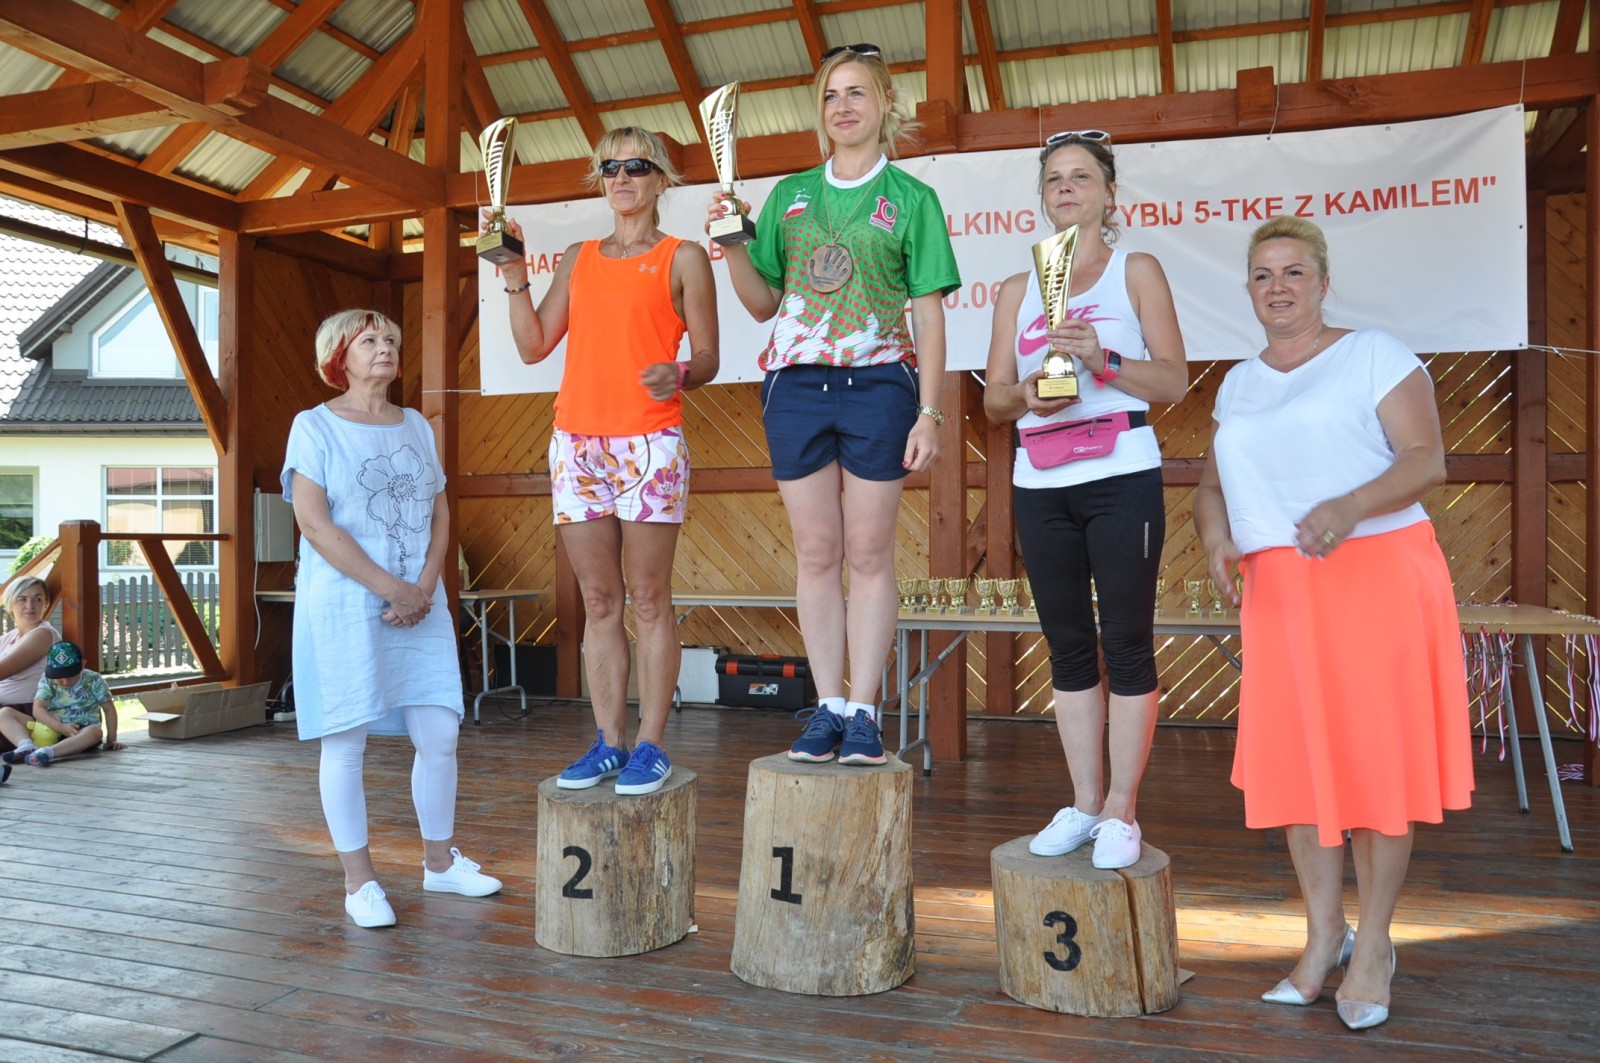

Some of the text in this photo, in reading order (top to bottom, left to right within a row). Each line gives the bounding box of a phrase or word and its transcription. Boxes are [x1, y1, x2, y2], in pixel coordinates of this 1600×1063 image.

[947, 209, 1036, 237] LKING
[1104, 200, 1183, 228] ZYBIJ
[1294, 194, 1315, 218] Z
[1325, 175, 1496, 216] KAMILEM"
[562, 845, 593, 899] 2
[771, 846, 802, 905] 1
[1043, 910, 1082, 971] 3
